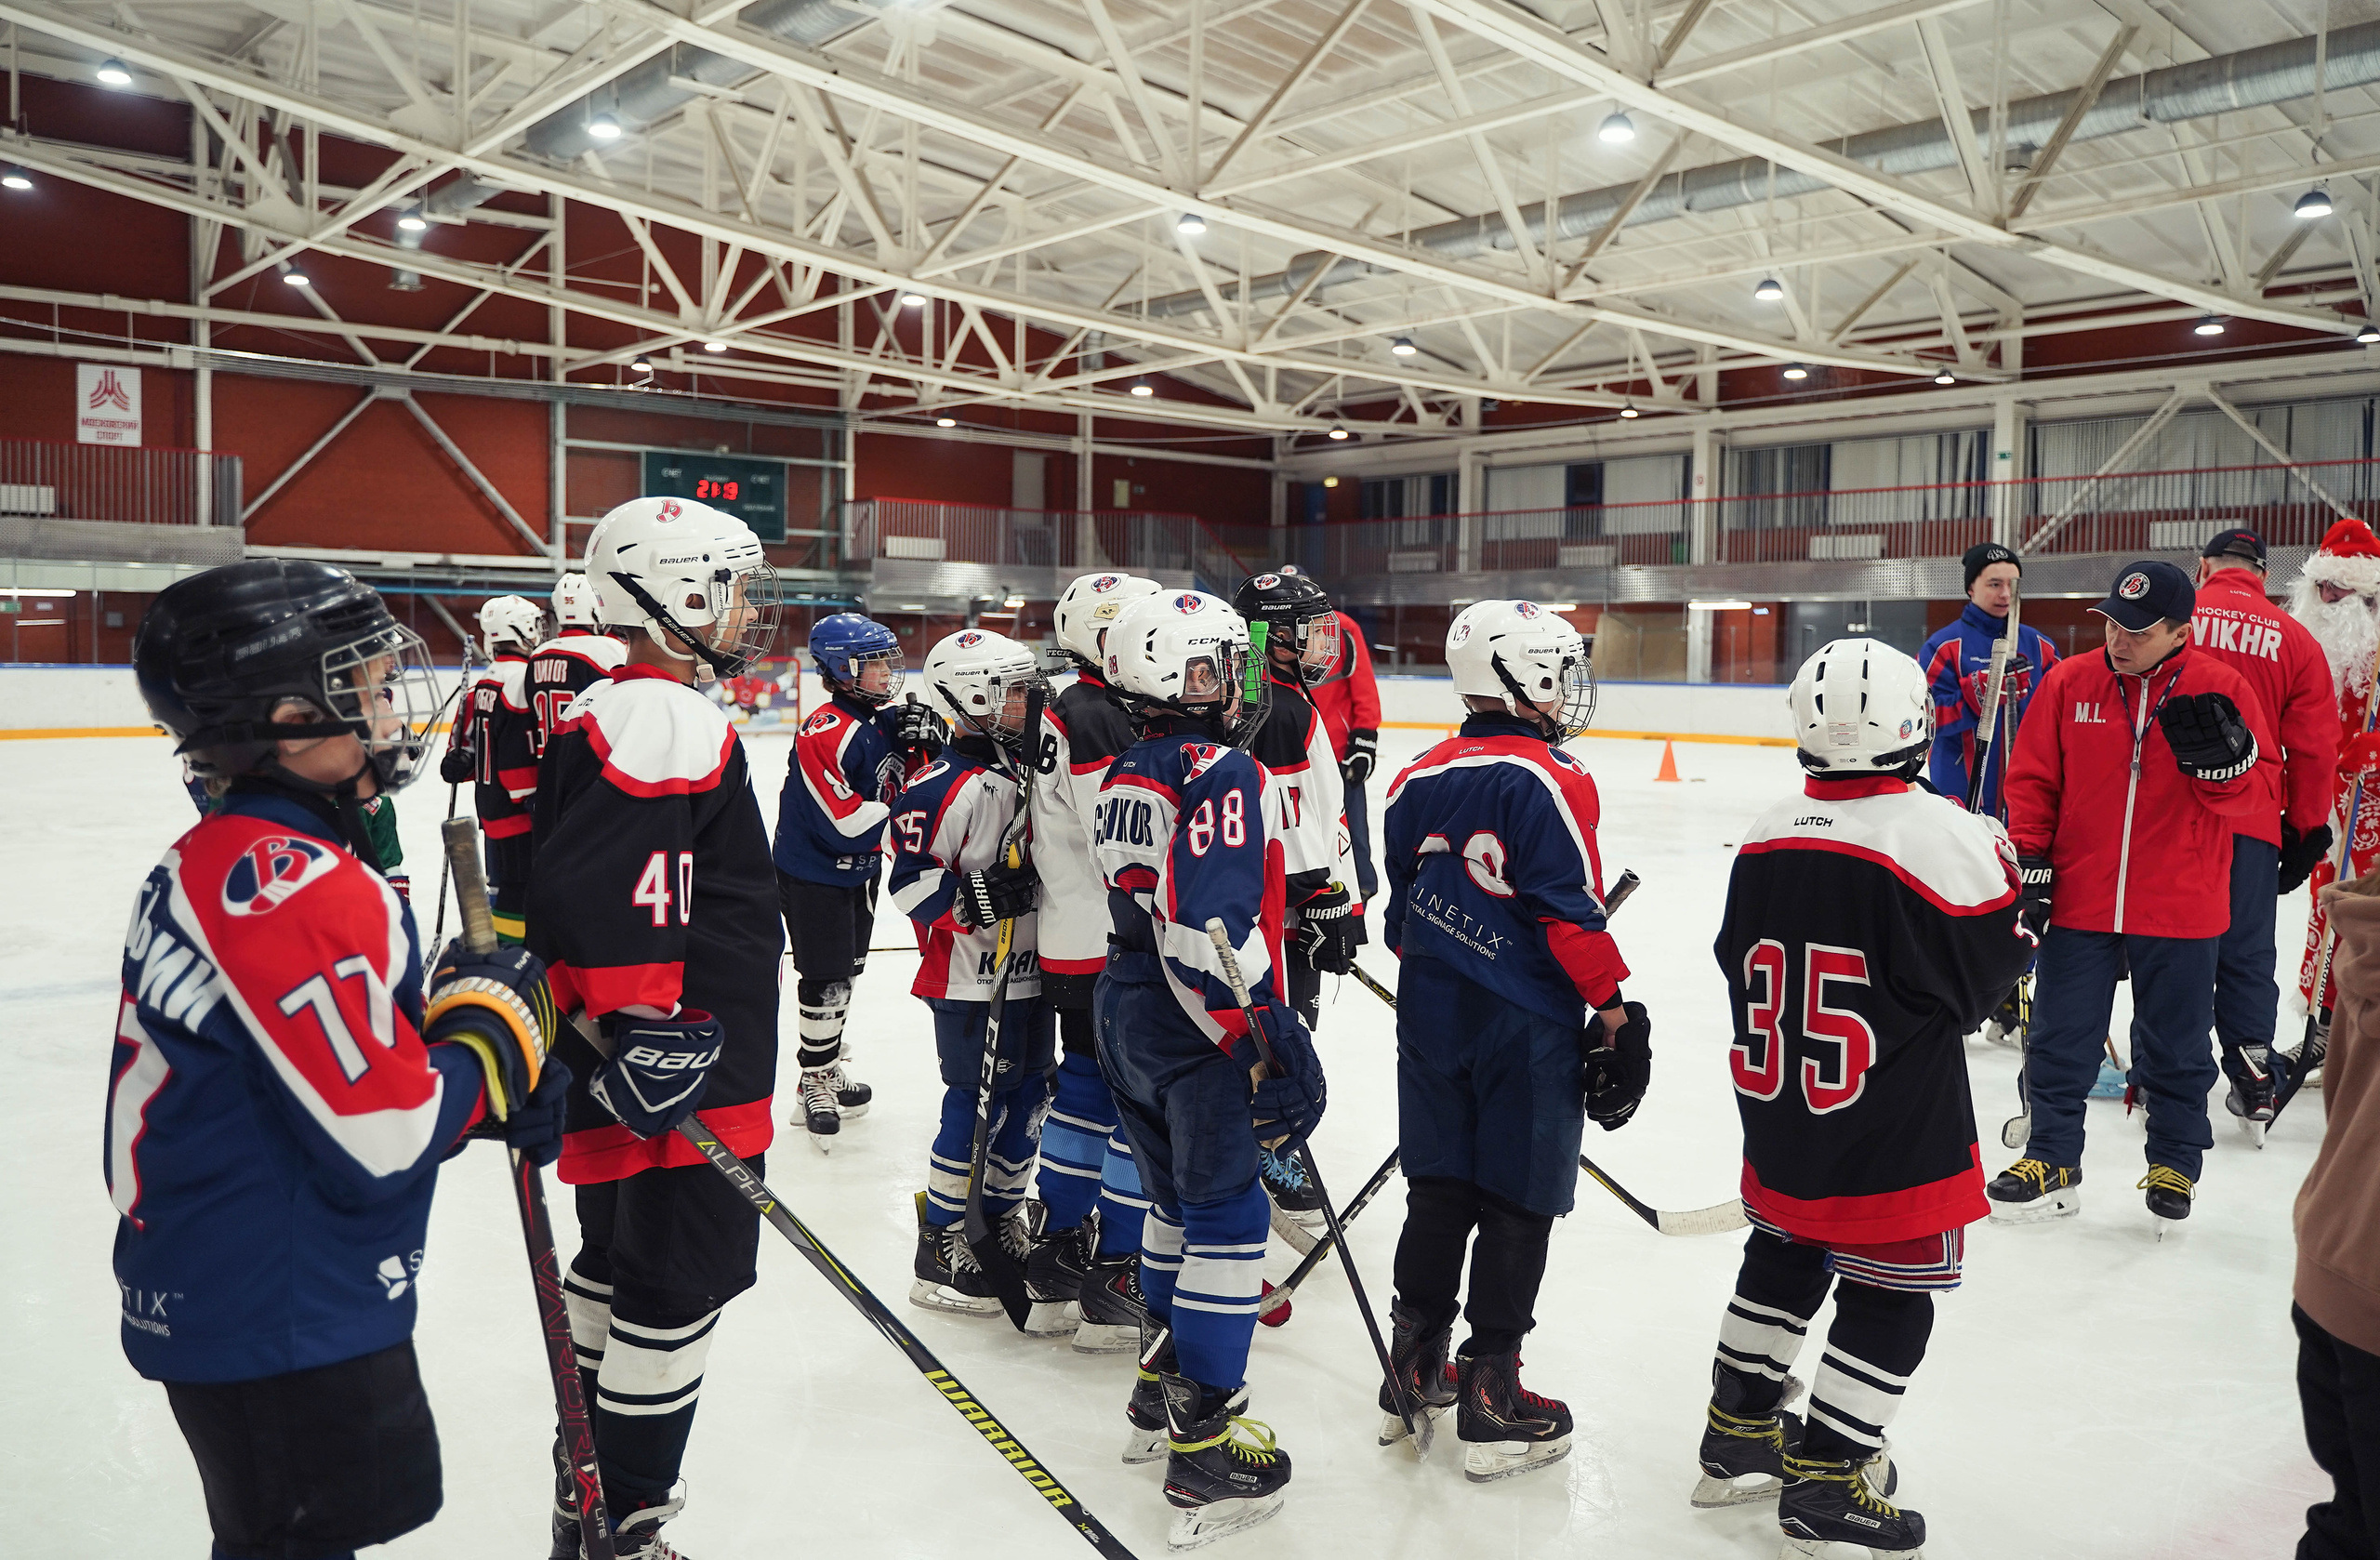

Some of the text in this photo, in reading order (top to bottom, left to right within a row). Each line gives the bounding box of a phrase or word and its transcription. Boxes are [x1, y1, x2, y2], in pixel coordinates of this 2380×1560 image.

[81, 417, 139, 430] МОСКОВСКИЙ
[97, 430, 124, 441] СПОРТ
[659, 556, 699, 564] BAUER
[661, 616, 696, 645] BAUER
[2197, 606, 2281, 628] HOCKEY CLUB
[1187, 638, 1221, 646] CCM
[2190, 615, 2282, 663] VIKHR
[2074, 701, 2107, 723] M.L.
[1459, 746, 1485, 754] LUTCH
[1188, 787, 1247, 858] 88
[1793, 816, 1833, 827] LUTCH
[631, 851, 694, 927] 40
[1427, 910, 1455, 935] SIGNAGE
[1455, 931, 1496, 960] SOLUTIONS
[2318, 943, 2334, 1008] NORDWAY
[276, 952, 397, 1087] 77
[1730, 938, 1876, 1115] 35
[976, 1016, 1000, 1121] CCM
[696, 1140, 775, 1216] ALPHA
[409, 1249, 423, 1272] S
[925, 1369, 1073, 1508] WARRIOR
[1230, 1473, 1256, 1483] BAUER
[594, 1507, 607, 1540] LITE
[1846, 1514, 1880, 1527] BAUER
